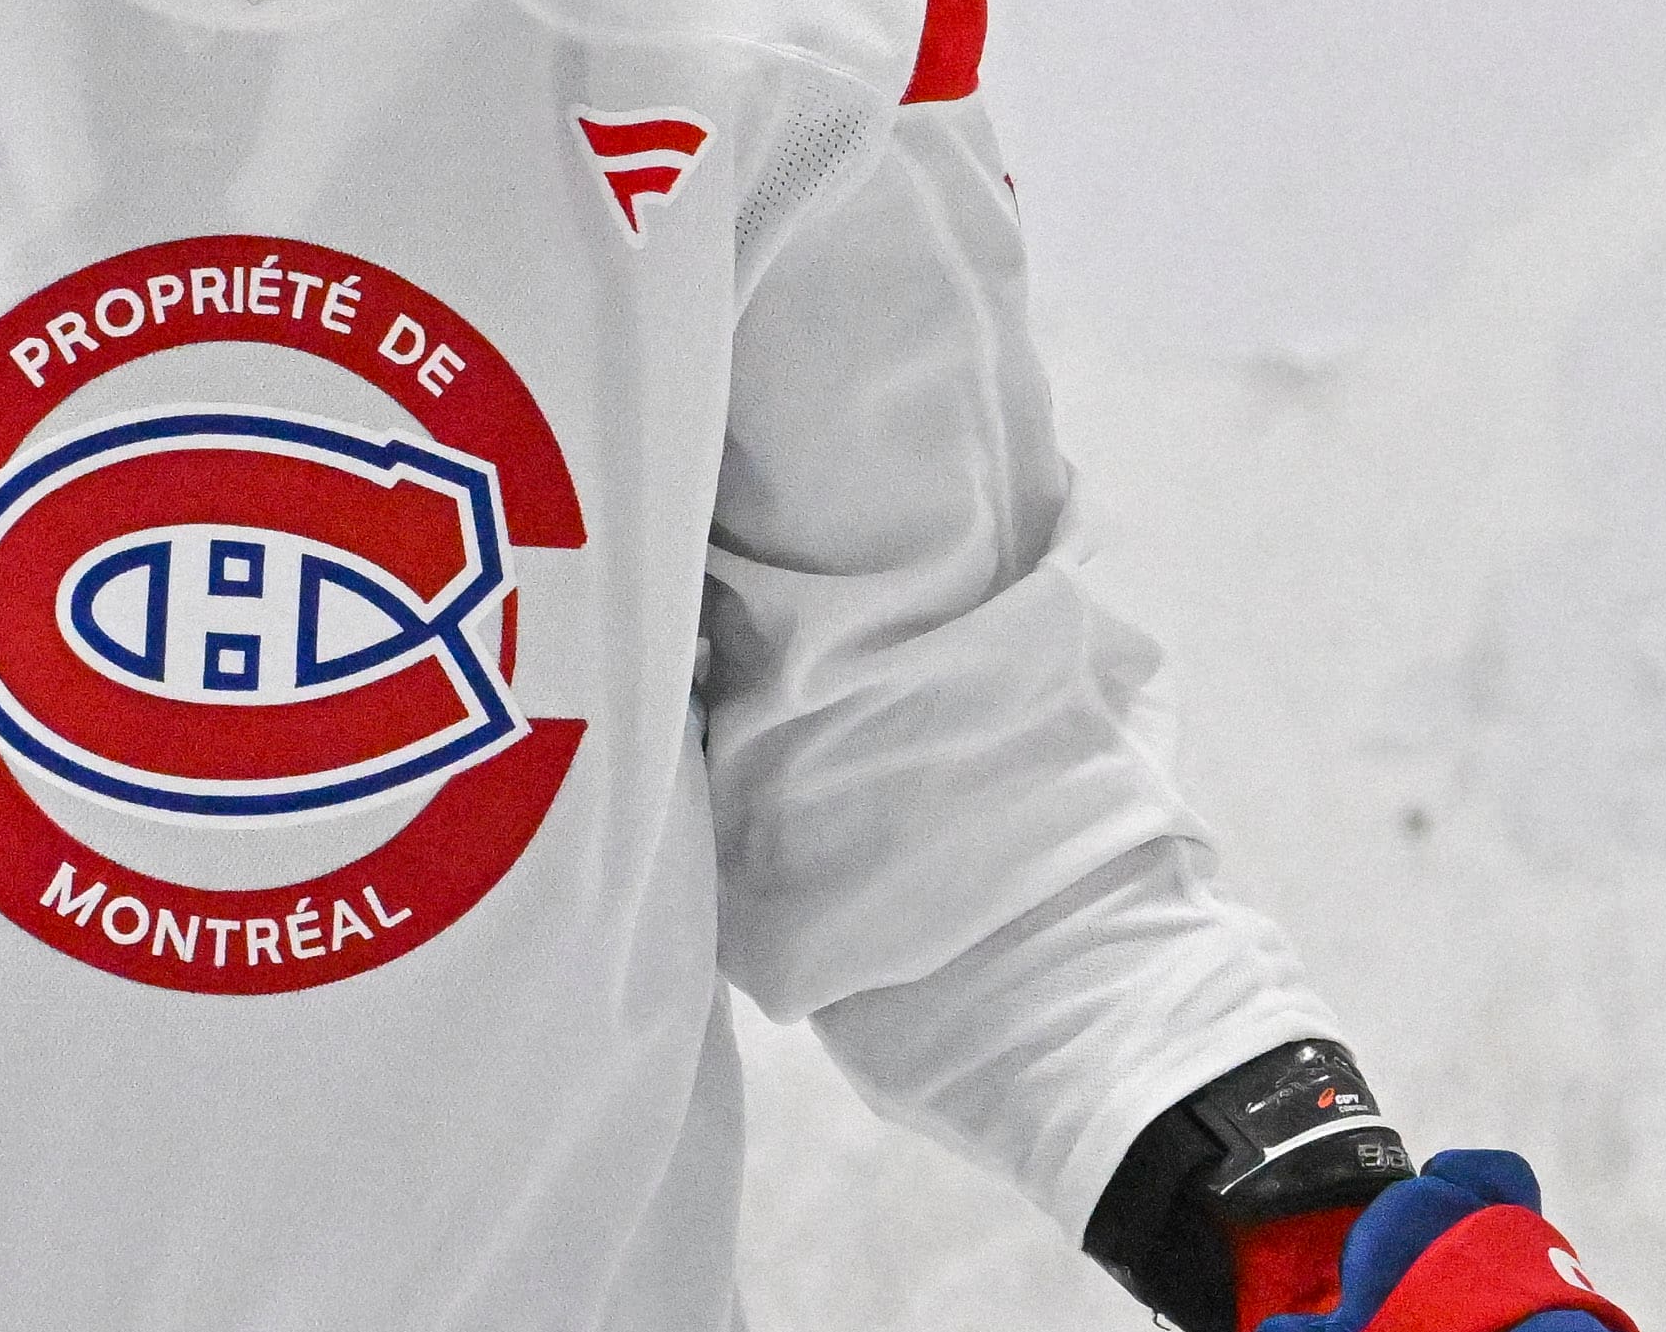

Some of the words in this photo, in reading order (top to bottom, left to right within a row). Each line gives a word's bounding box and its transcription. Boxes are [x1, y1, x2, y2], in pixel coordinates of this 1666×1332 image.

[9, 254, 363, 388] PROPRIÉTÉ
[377, 312, 466, 398] DE
[39, 861, 413, 967] MONTRÉAL
